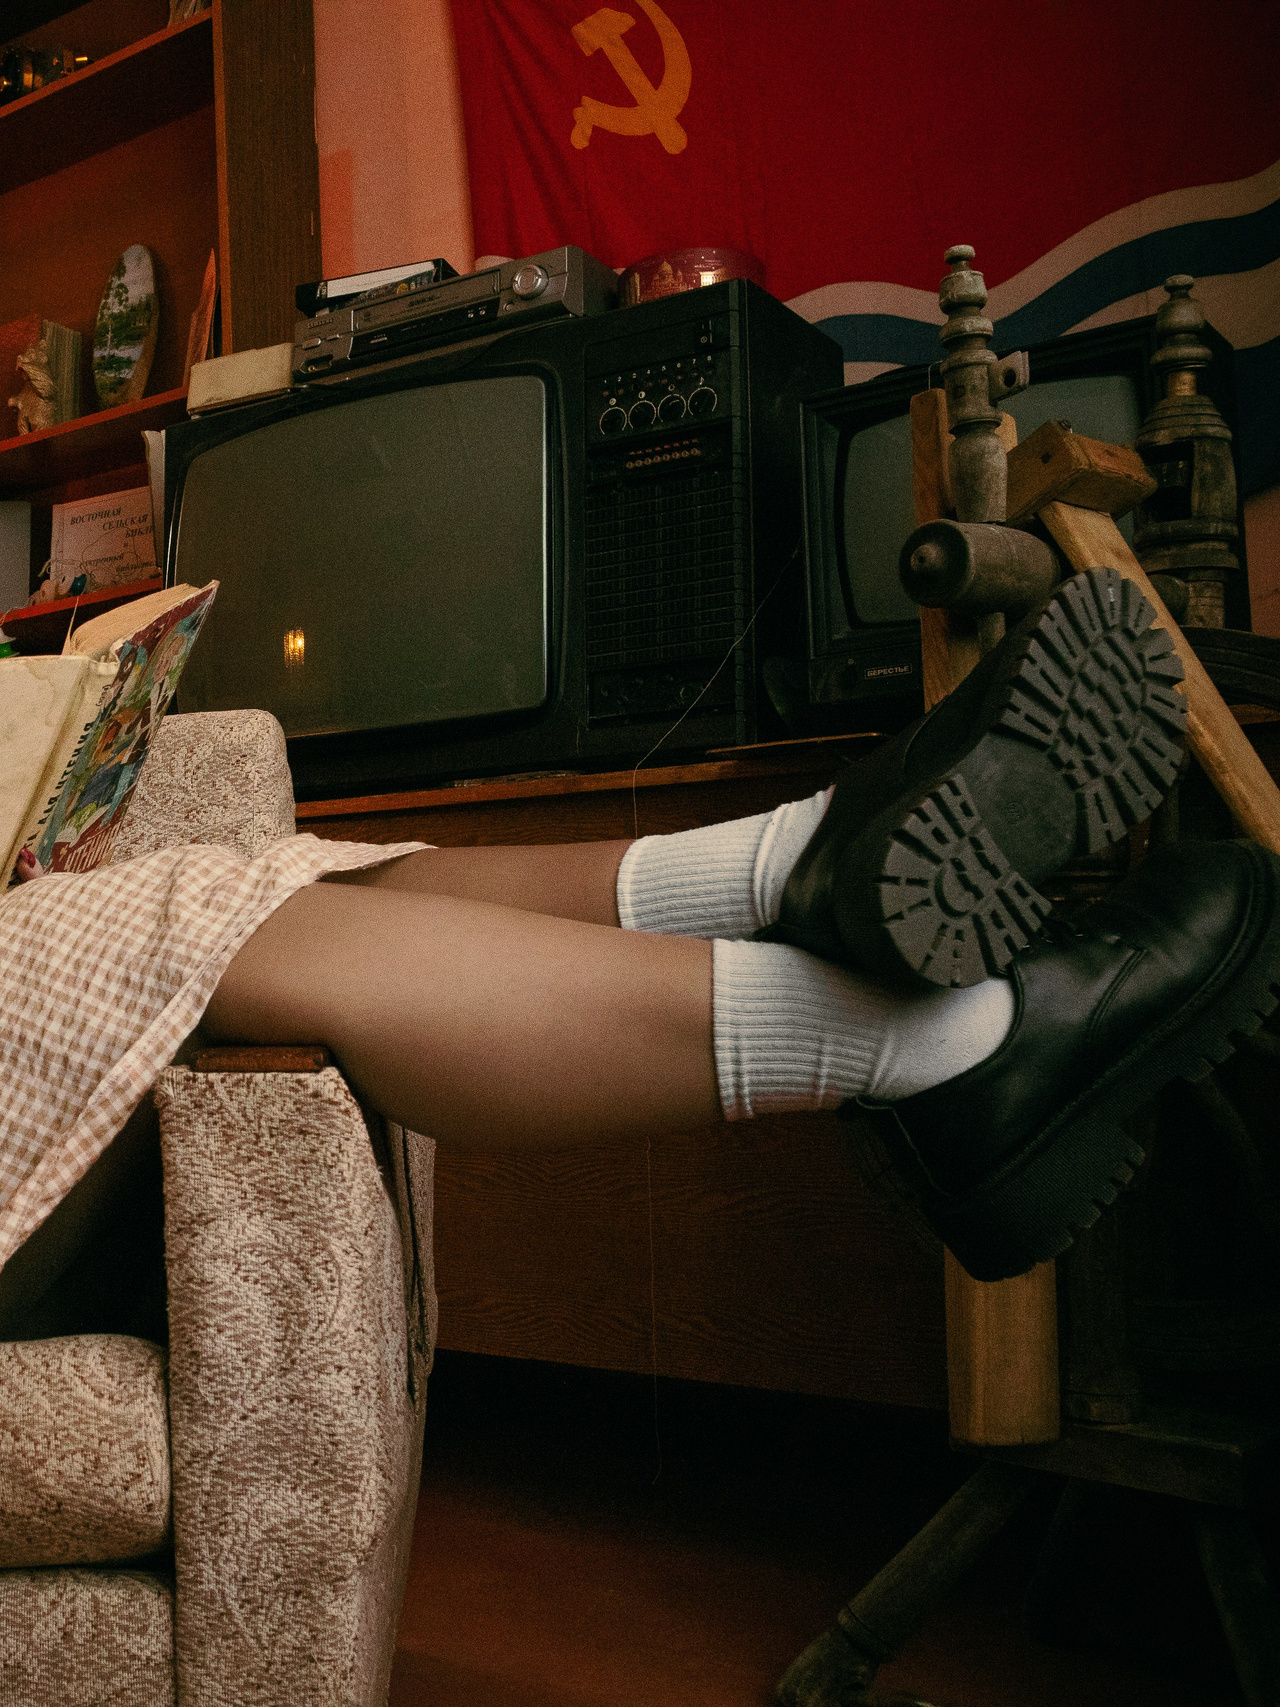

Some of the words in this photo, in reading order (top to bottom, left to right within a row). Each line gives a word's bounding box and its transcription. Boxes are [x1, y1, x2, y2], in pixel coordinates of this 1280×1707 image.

[70, 508, 122, 526] ВОСТОЧНАЯ
[102, 514, 149, 531] СЕЛЬСКАЯ
[867, 665, 909, 677] БЕРЕСТЬЕ
[37, 795, 61, 825] ДЛЯ
[55, 720, 96, 790] ЧТЕНИЯ
